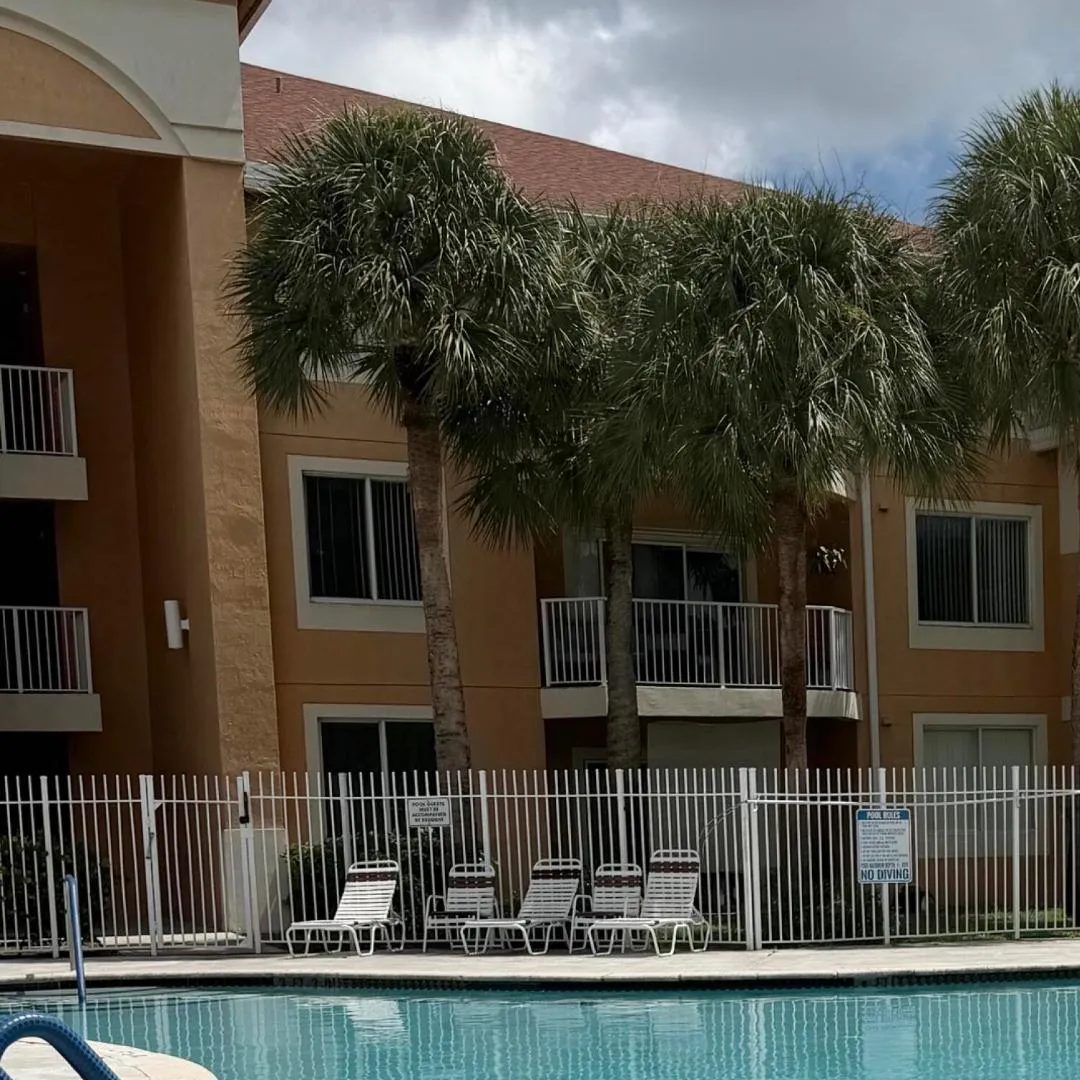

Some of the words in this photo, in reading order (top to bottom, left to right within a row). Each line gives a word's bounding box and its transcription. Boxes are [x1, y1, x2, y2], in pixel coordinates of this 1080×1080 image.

[867, 811, 881, 819] POOL
[883, 811, 901, 819] RULES
[861, 869, 875, 881] NO
[877, 868, 909, 880] DIVING
